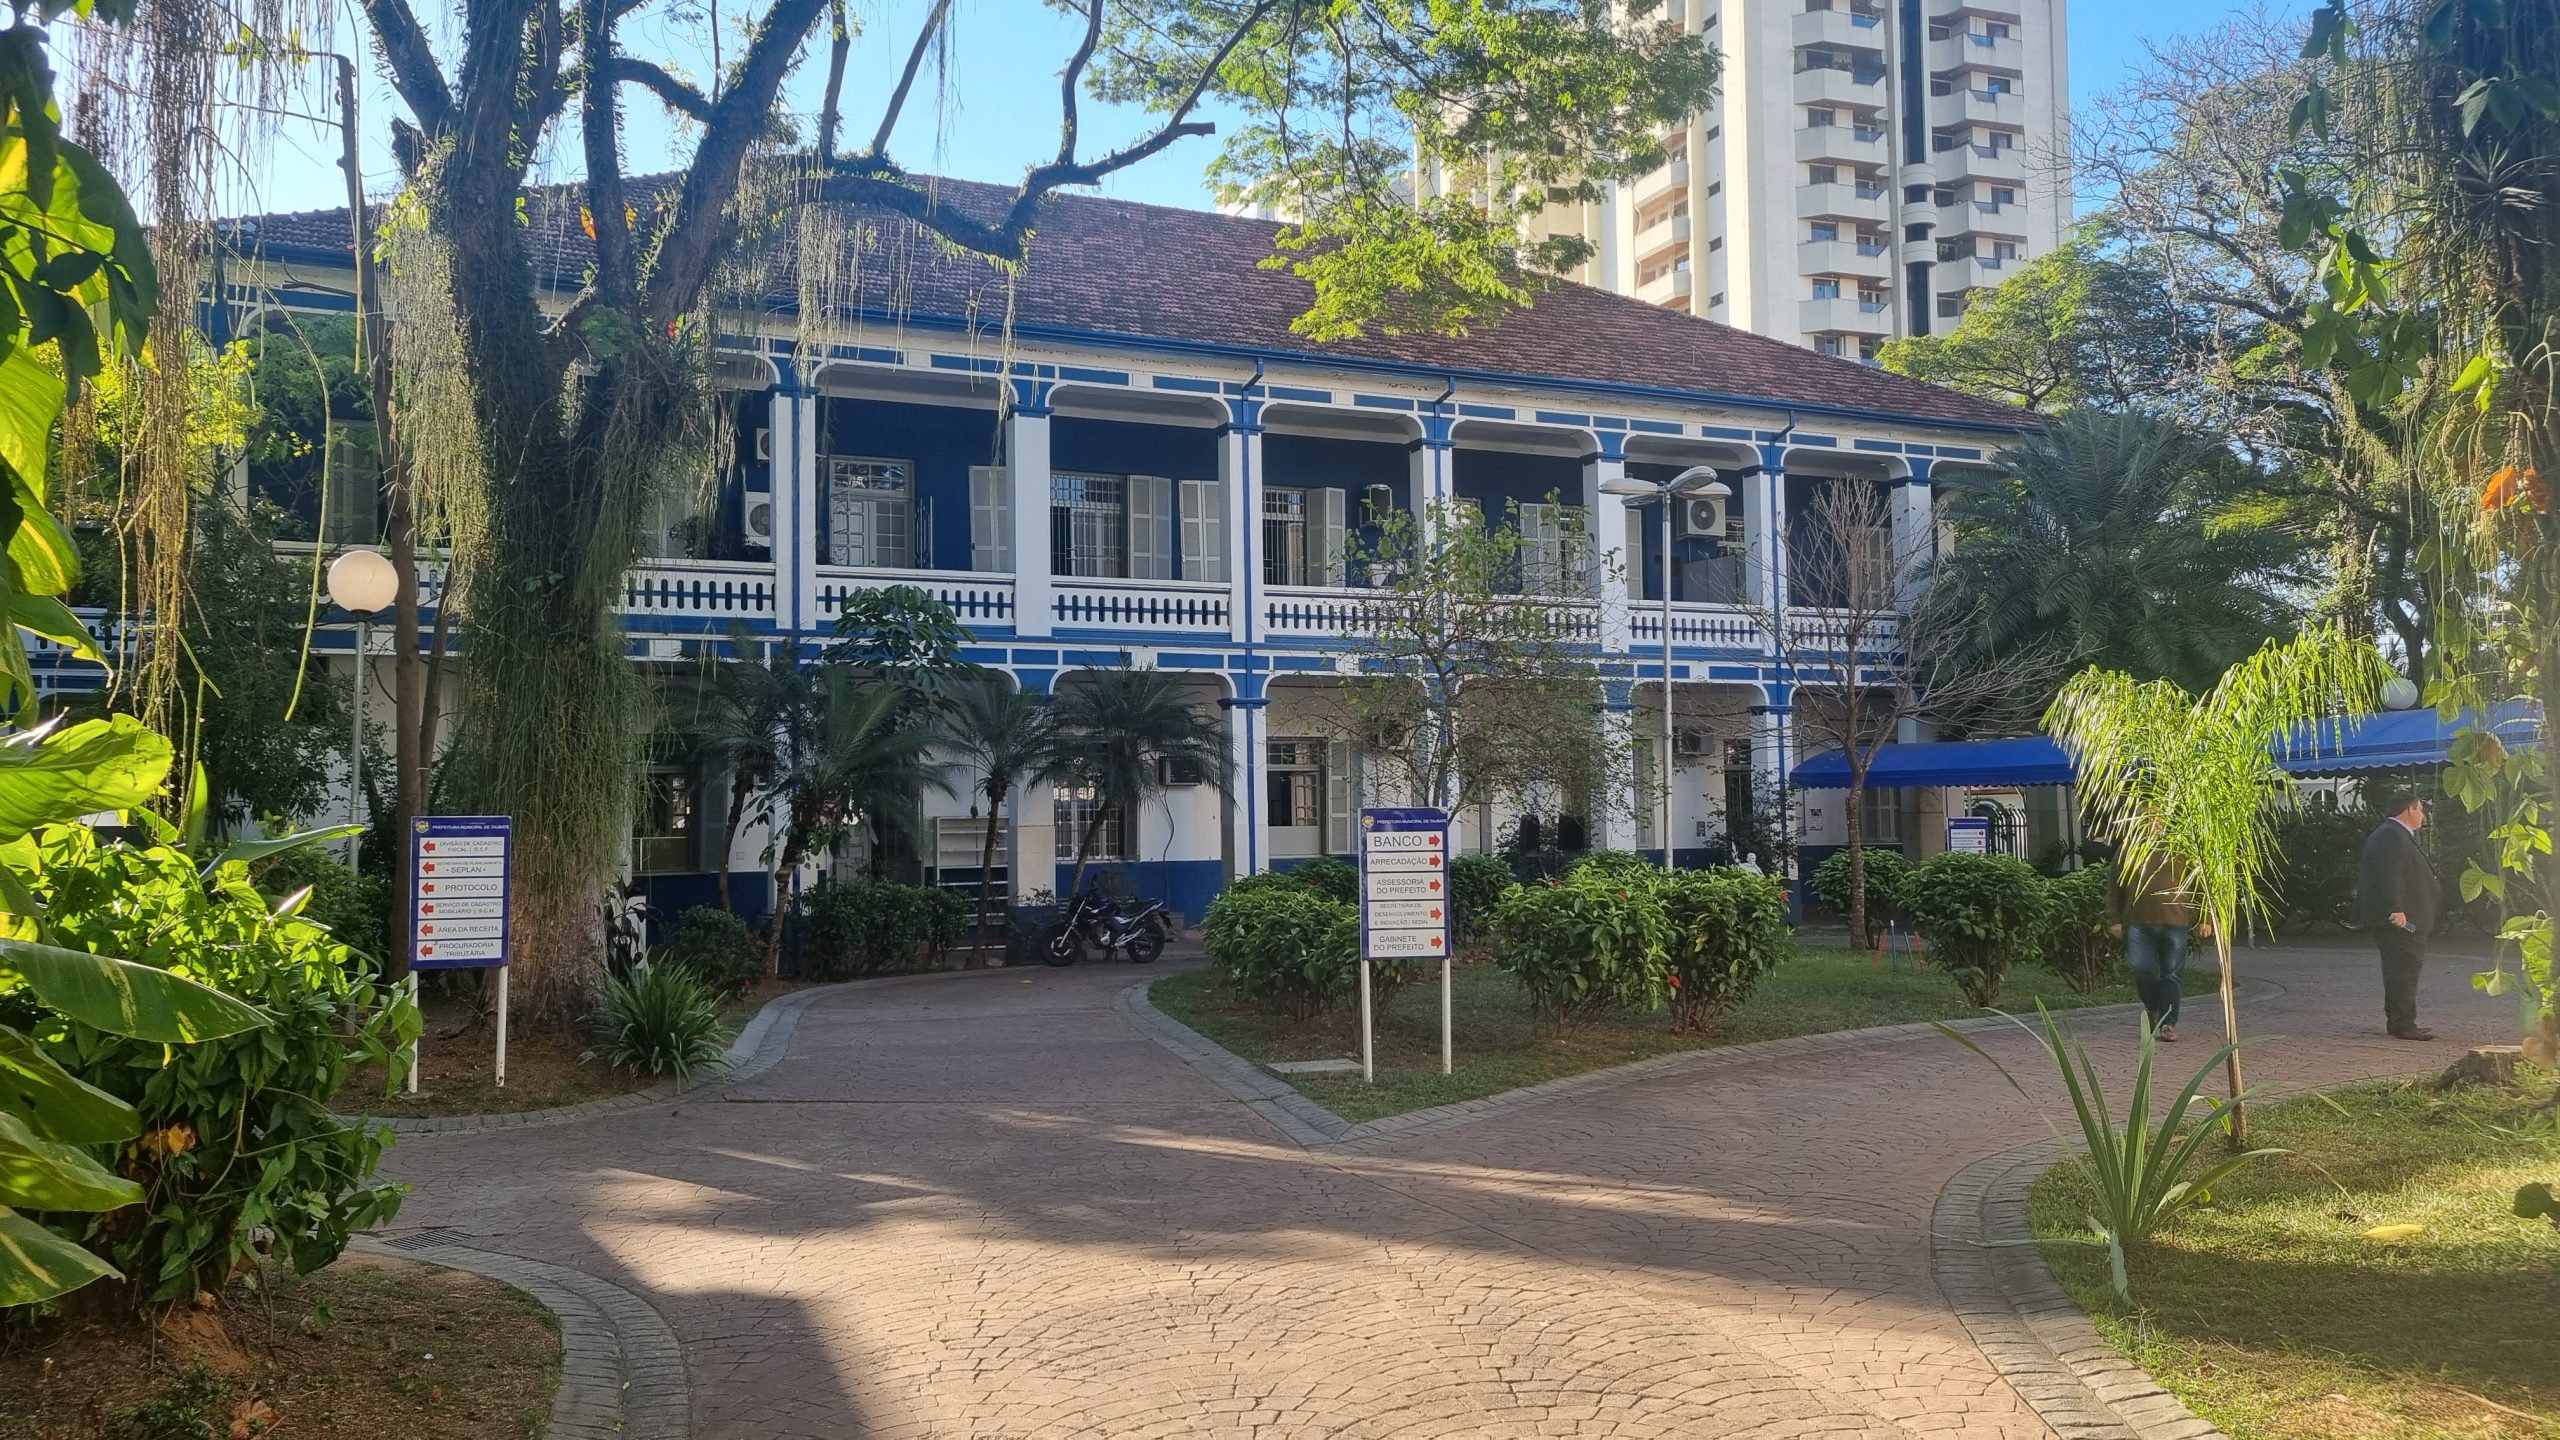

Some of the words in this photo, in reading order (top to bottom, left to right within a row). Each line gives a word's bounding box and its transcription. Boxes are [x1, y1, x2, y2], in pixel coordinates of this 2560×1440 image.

[1374, 836, 1422, 847] BANCO
[1370, 857, 1427, 866] ARRECADAÇÃO
[1379, 935, 1416, 943] GABINETE
